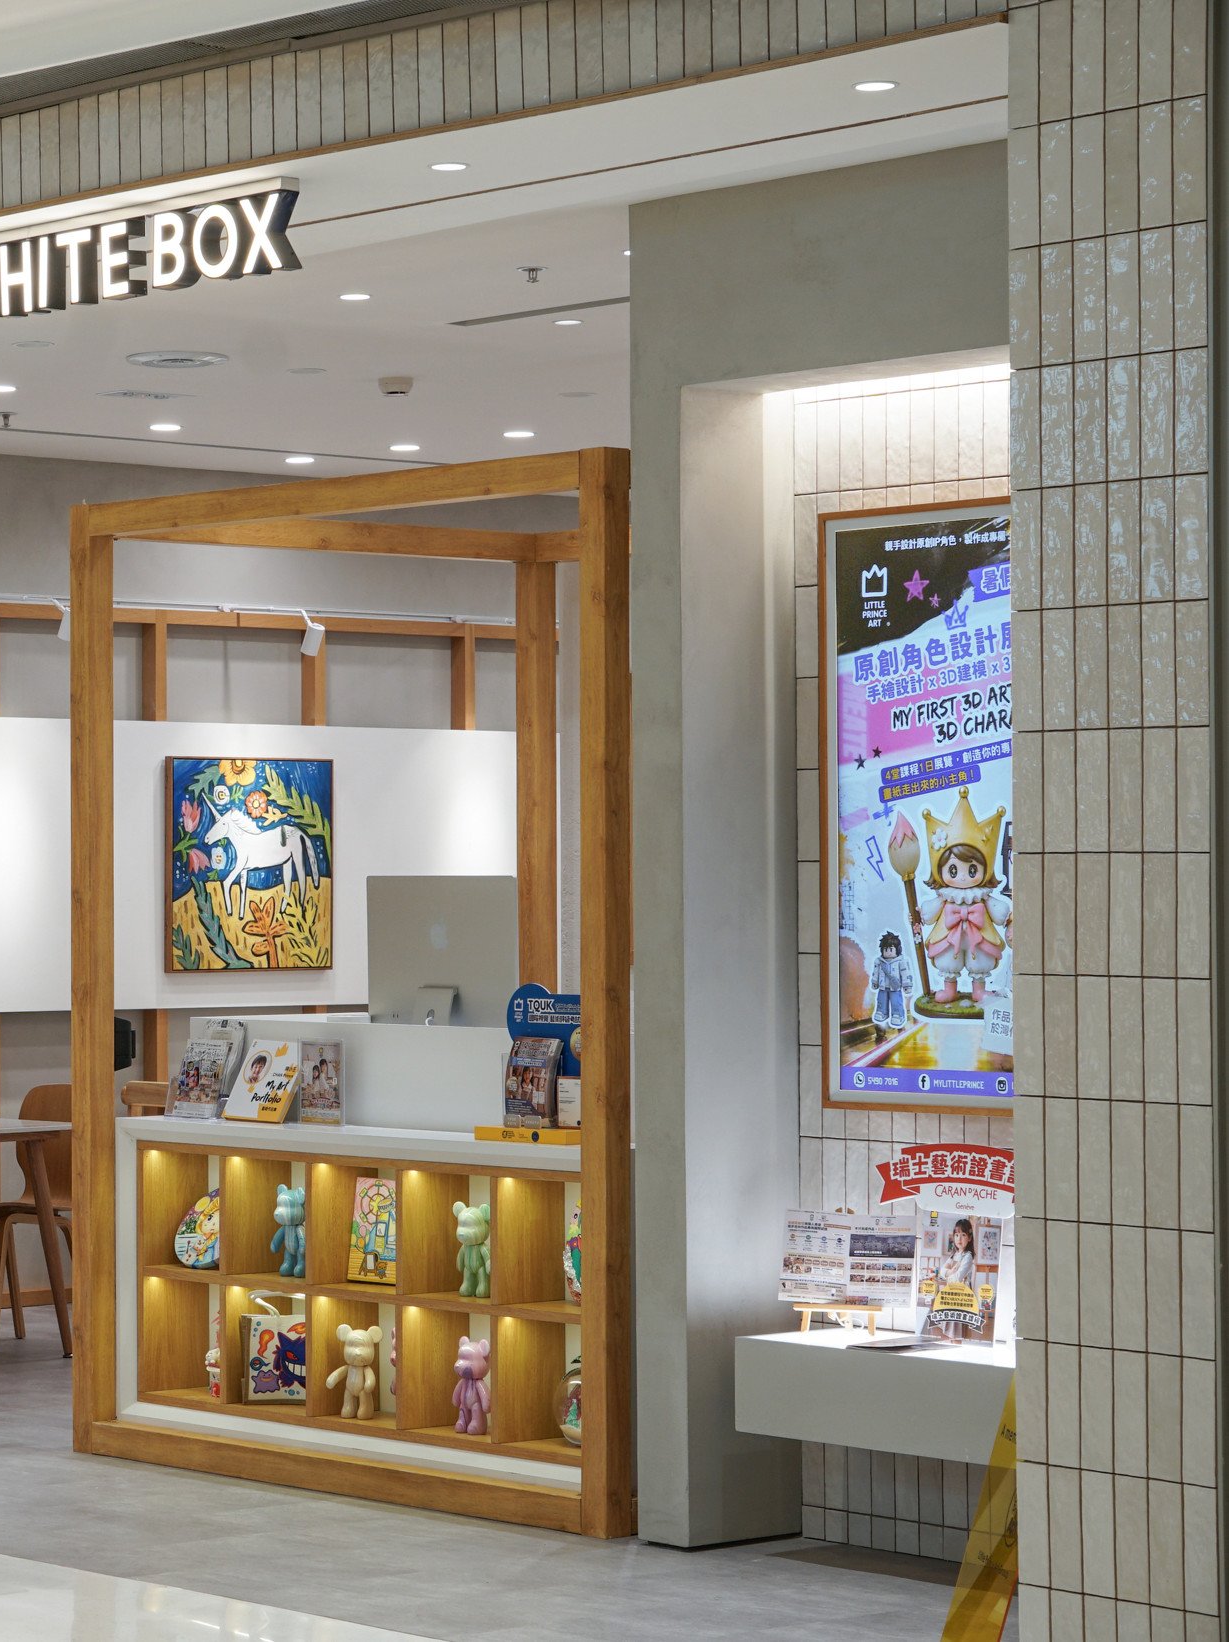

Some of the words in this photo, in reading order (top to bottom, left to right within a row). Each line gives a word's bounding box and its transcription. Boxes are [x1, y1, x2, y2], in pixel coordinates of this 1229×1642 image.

[153, 193, 283, 288] BOX
[885, 530, 1010, 551] 親手設計原創IP角色，製作成專屬
[864, 600, 885, 610] LITTLE
[862, 610, 888, 619] PRINCE
[868, 619, 881, 627] ART
[939, 660, 987, 686] 3D建模
[892, 707, 912, 729] MY
[916, 696, 957, 724] FIRST
[961, 691, 982, 712] 3D
[935, 721, 958, 744] 3D
[963, 708, 1011, 737] CHAR
[527, 999, 554, 1012] TQUK
[992, 1009, 1013, 1023] 作品
[265, 1080, 276, 1091] My
[934, 1184, 967, 1199] CARAN
